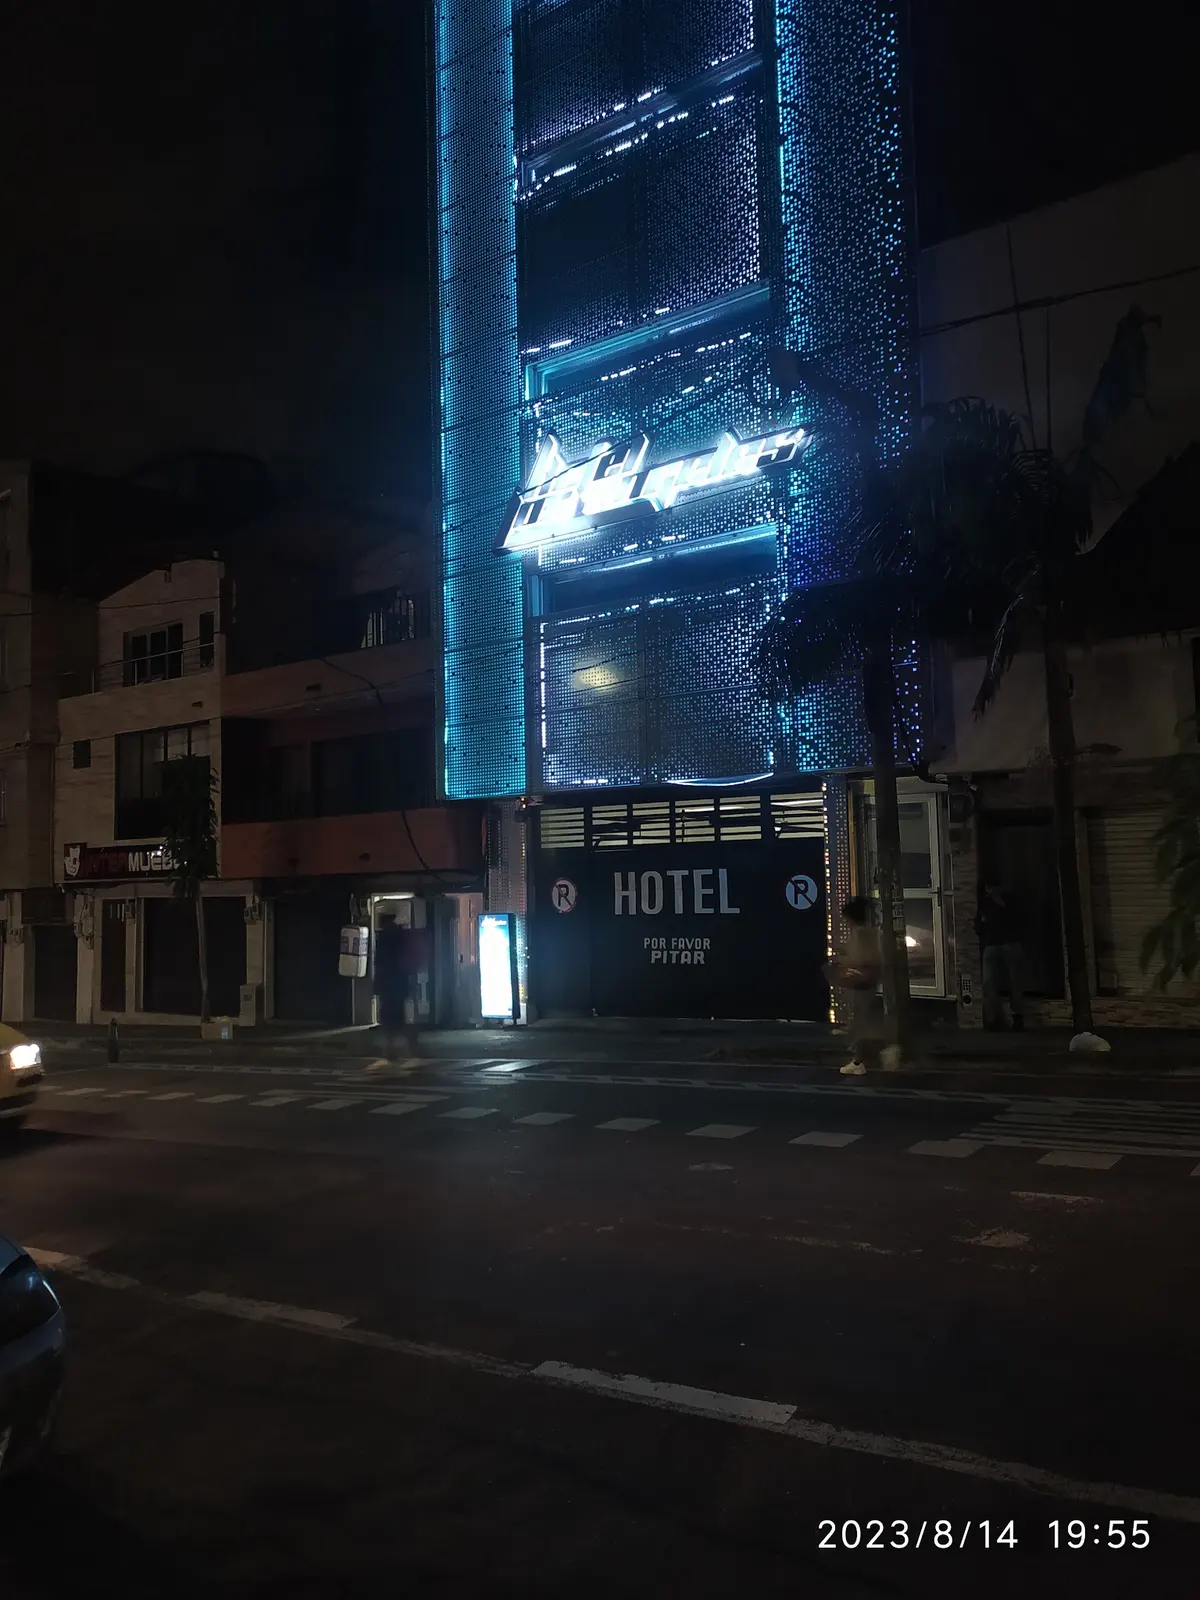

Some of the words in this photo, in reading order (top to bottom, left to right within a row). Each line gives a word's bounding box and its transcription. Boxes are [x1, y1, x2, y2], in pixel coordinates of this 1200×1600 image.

[614, 868, 741, 916] HOTEL
[643, 937, 667, 950] POR
[671, 937, 712, 950] FAVOR
[650, 950, 707, 965] PITAR
